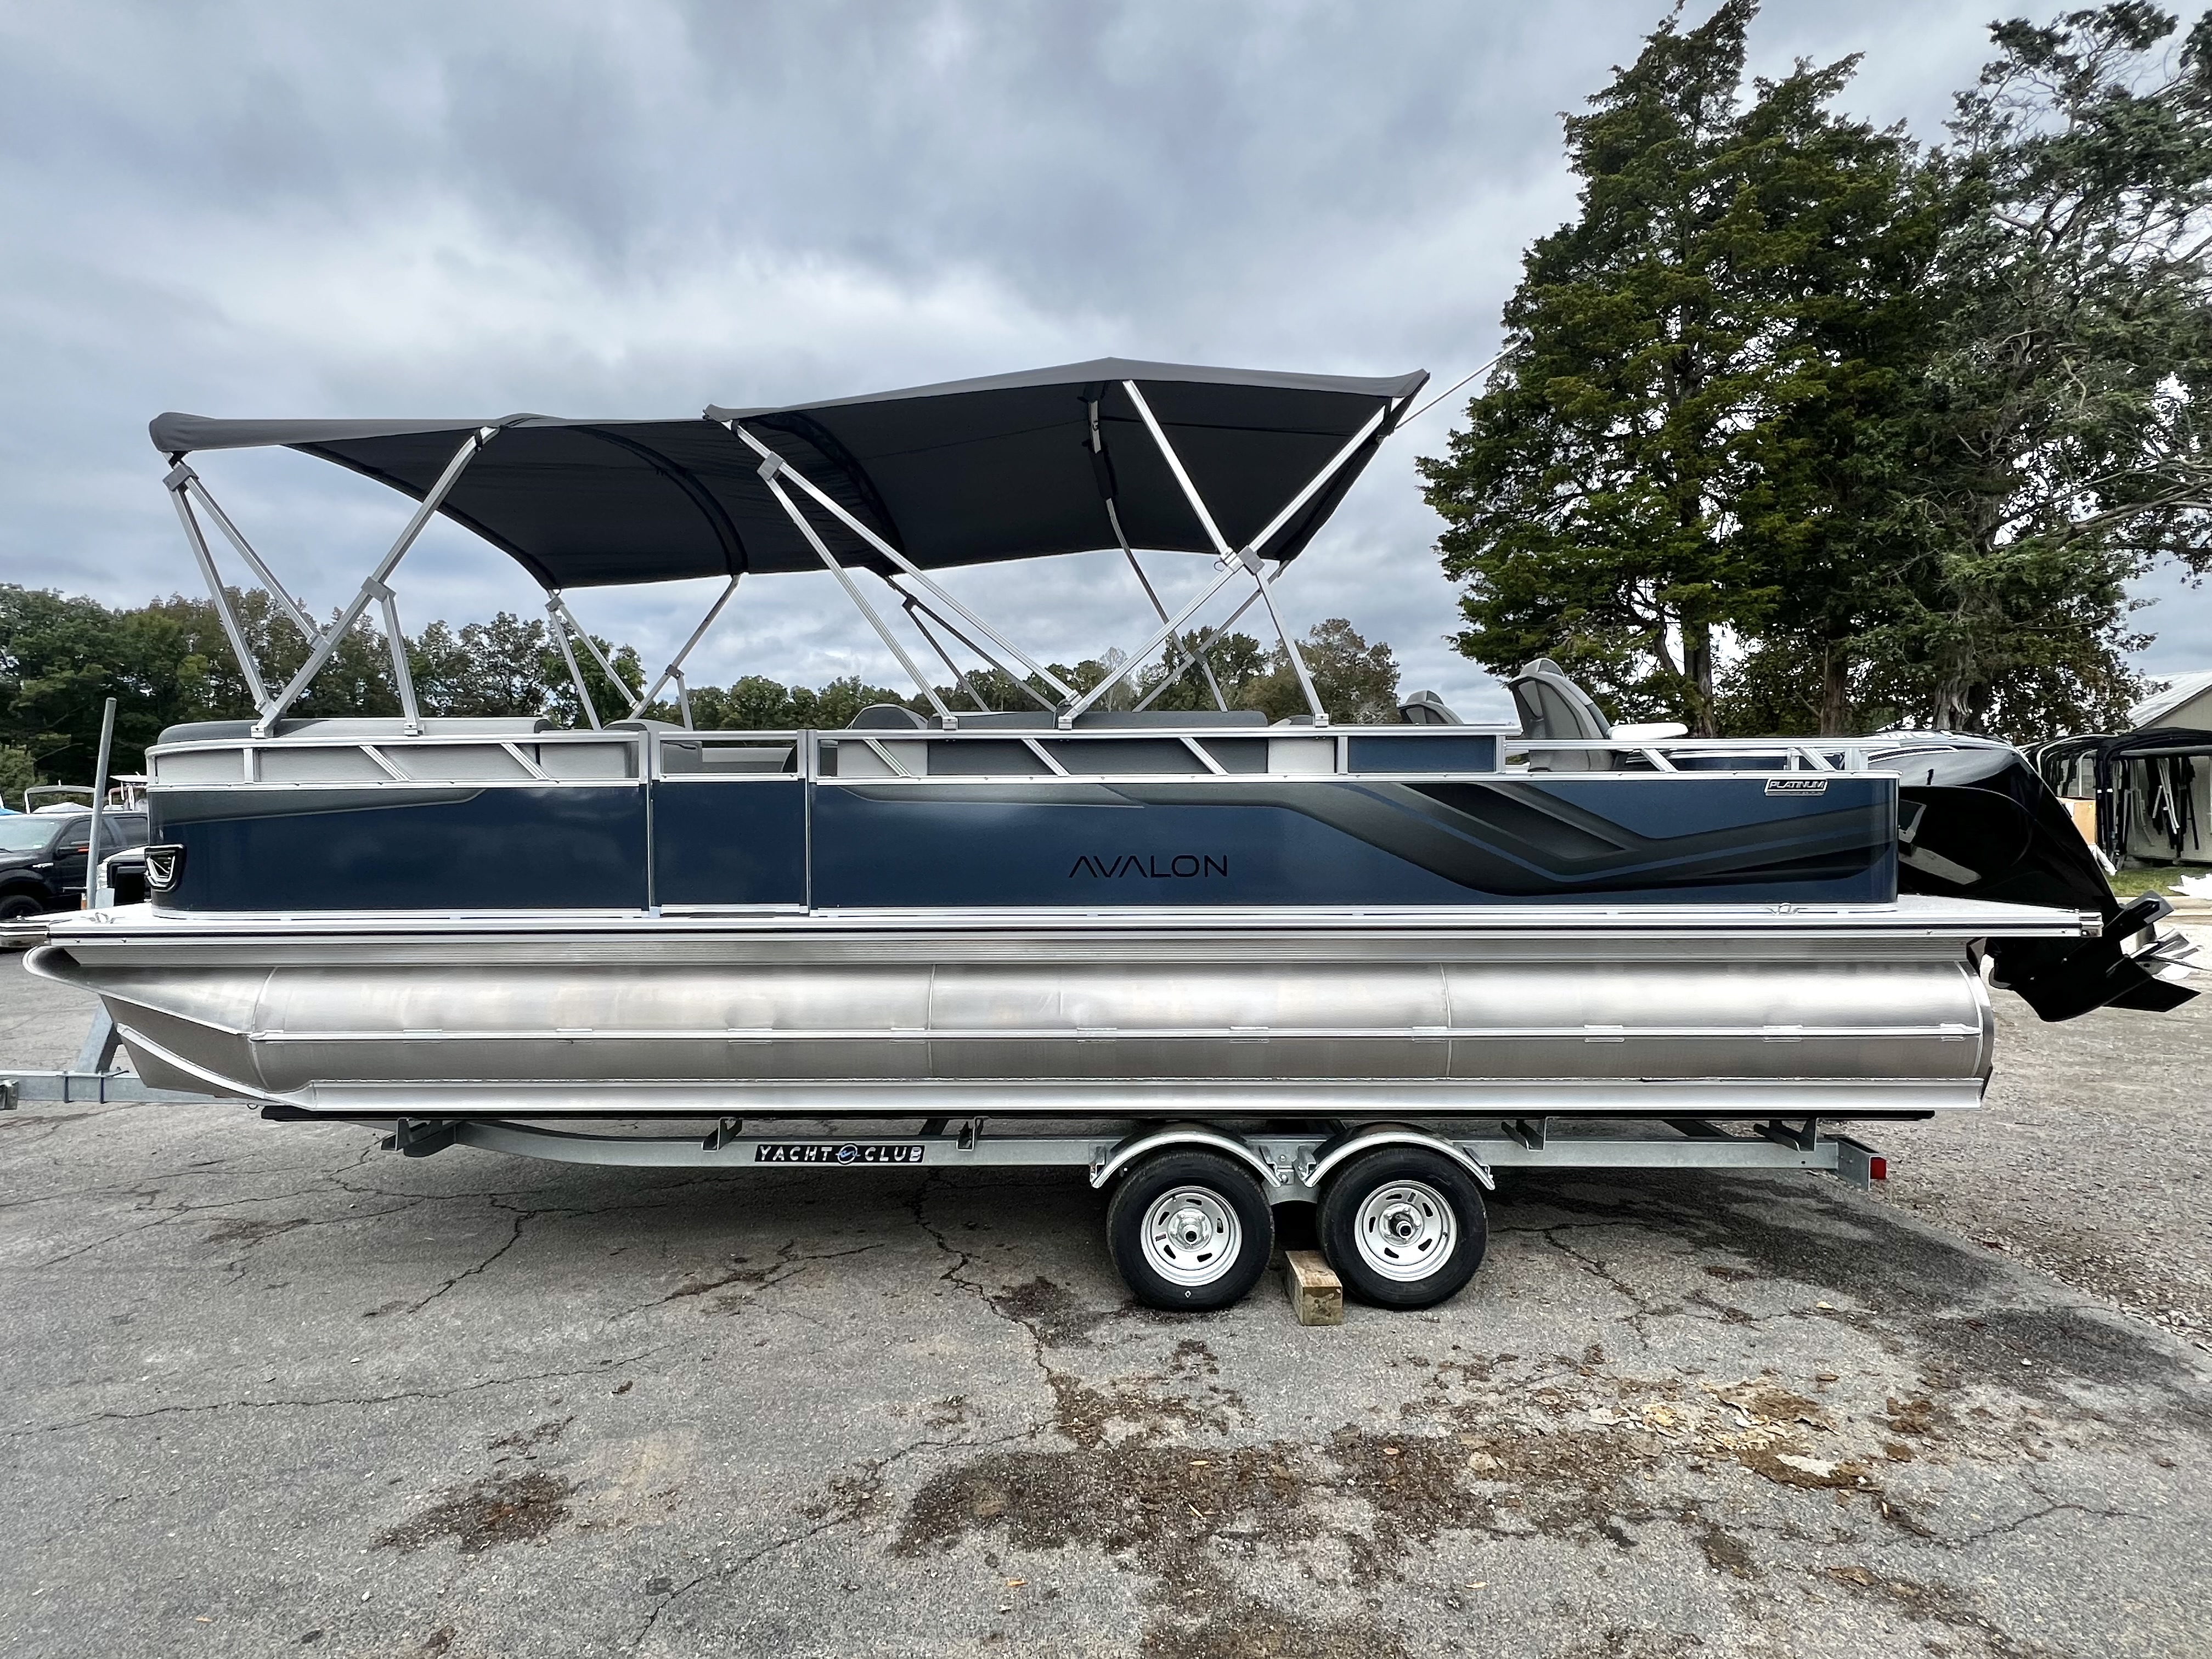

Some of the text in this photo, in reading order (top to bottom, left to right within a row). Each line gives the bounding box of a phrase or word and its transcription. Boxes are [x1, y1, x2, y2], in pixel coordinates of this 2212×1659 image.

[1769, 781, 1825, 789] PLATINUM
[1069, 855, 1228, 878] AVALON
[760, 1146, 922, 1161] YACHT CLUB
